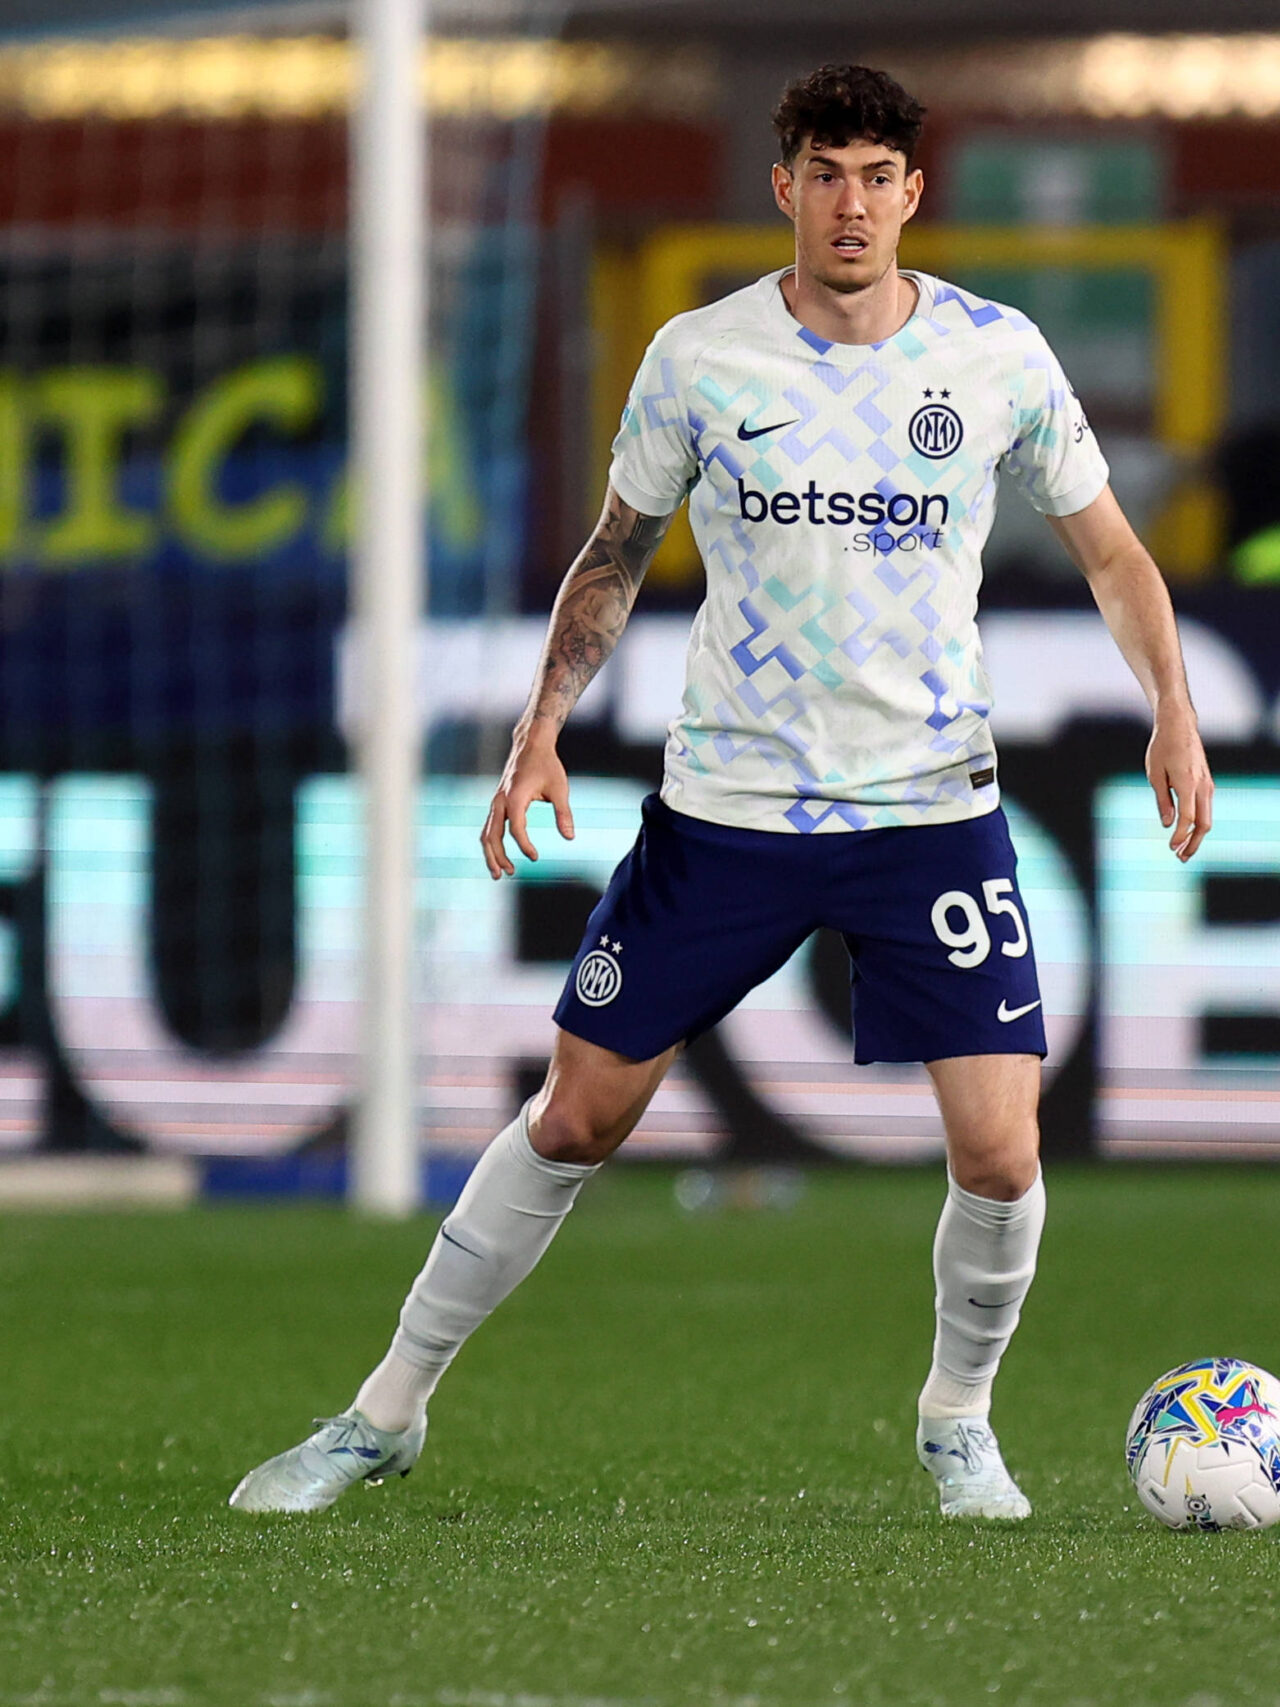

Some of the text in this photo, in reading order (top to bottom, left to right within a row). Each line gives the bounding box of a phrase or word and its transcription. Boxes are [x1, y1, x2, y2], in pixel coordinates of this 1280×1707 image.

[0, 355, 483, 565] ICA
[738, 478, 949, 526] betsson
[844, 528, 944, 557] .sport
[931, 878, 1029, 969] 95
